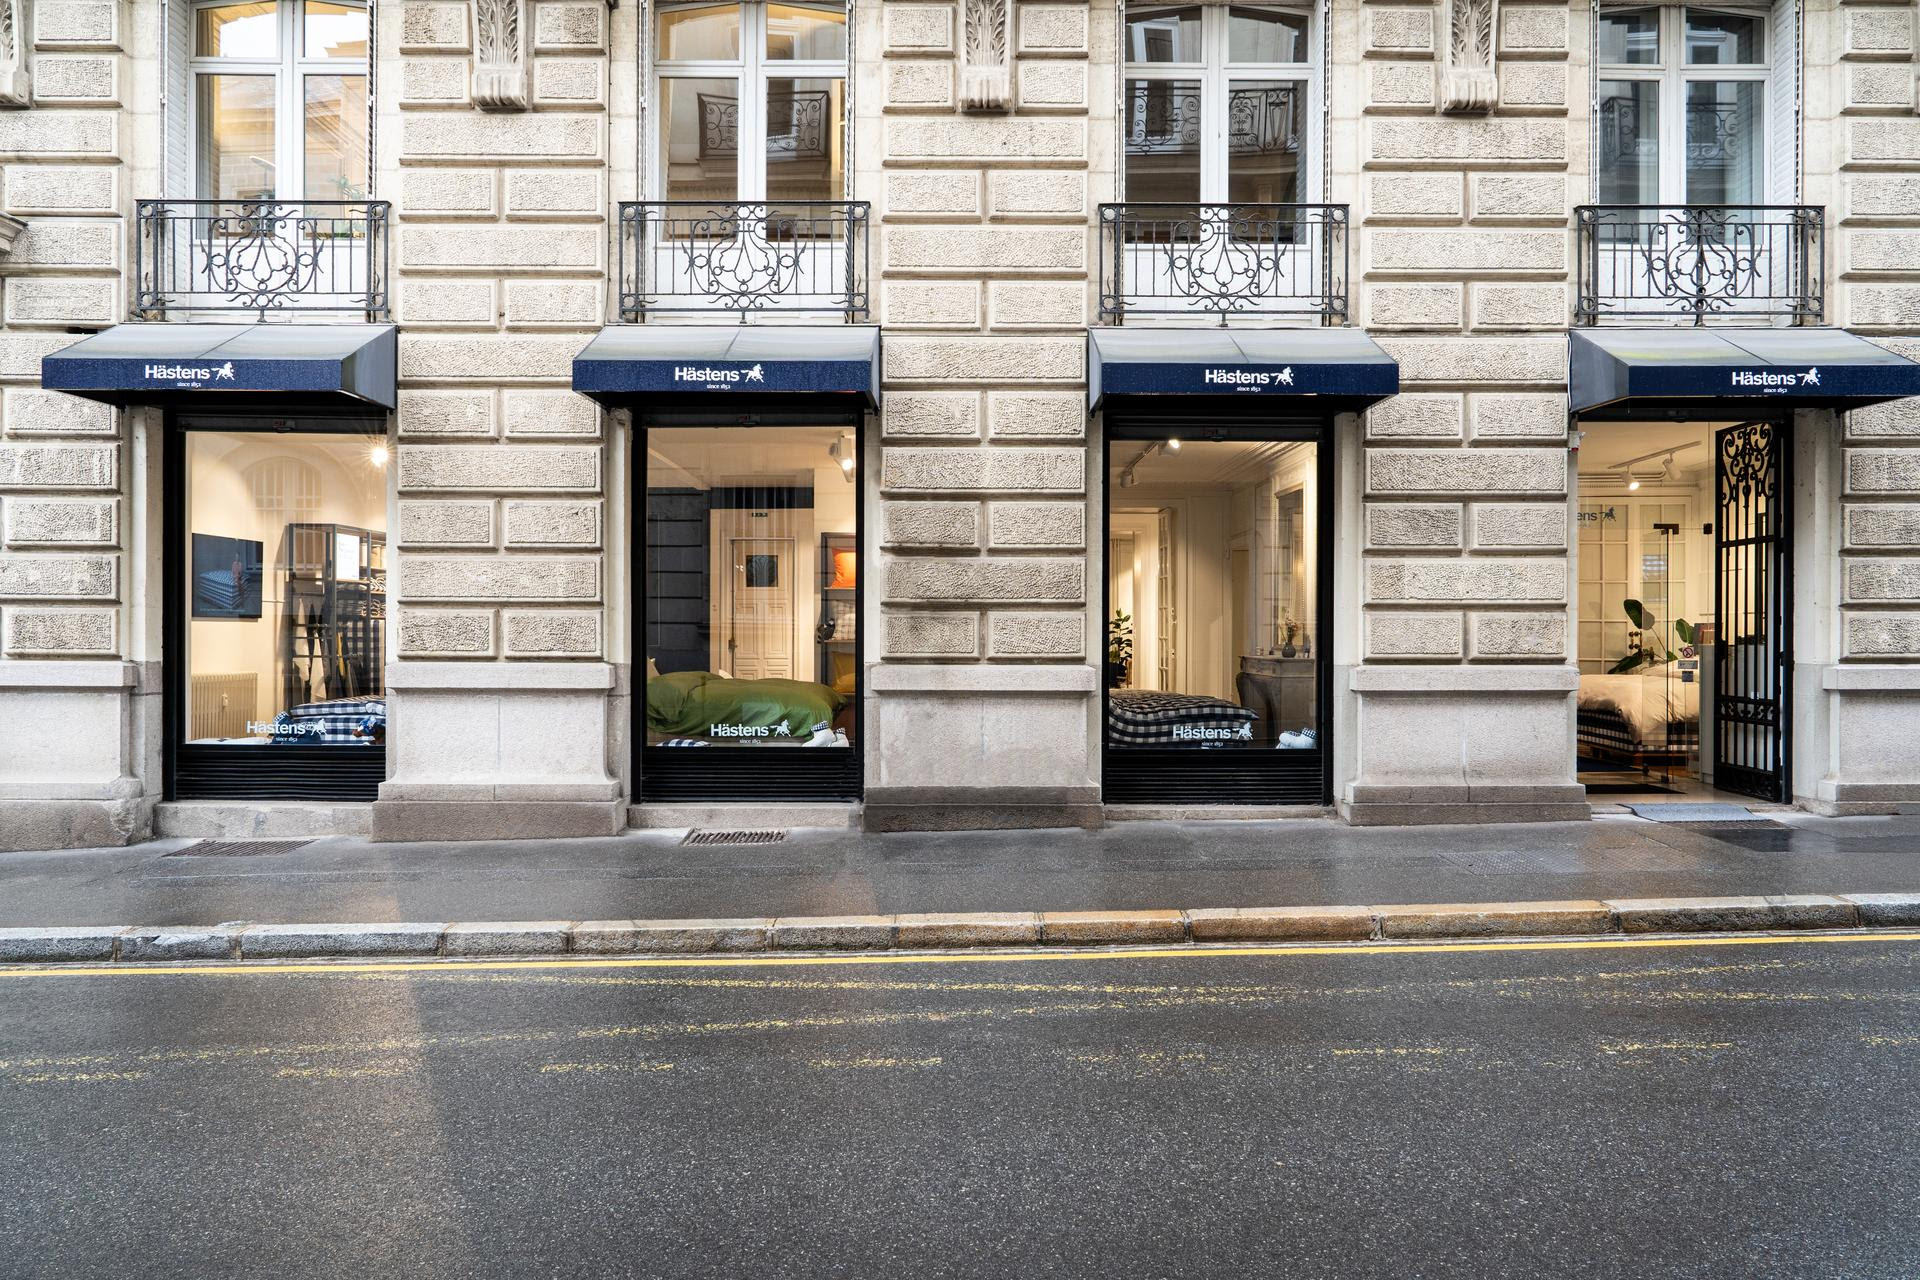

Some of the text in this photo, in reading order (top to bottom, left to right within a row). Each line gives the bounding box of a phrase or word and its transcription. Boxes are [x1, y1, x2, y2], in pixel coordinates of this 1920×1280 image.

[145, 364, 210, 379] Hästens
[675, 367, 739, 381] Hästens
[1205, 369, 1270, 384] Hästens
[1732, 371, 1796, 385] Hästens
[247, 721, 306, 734] Hästens
[711, 723, 769, 737] Hästens
[1173, 725, 1231, 739] Hästens
